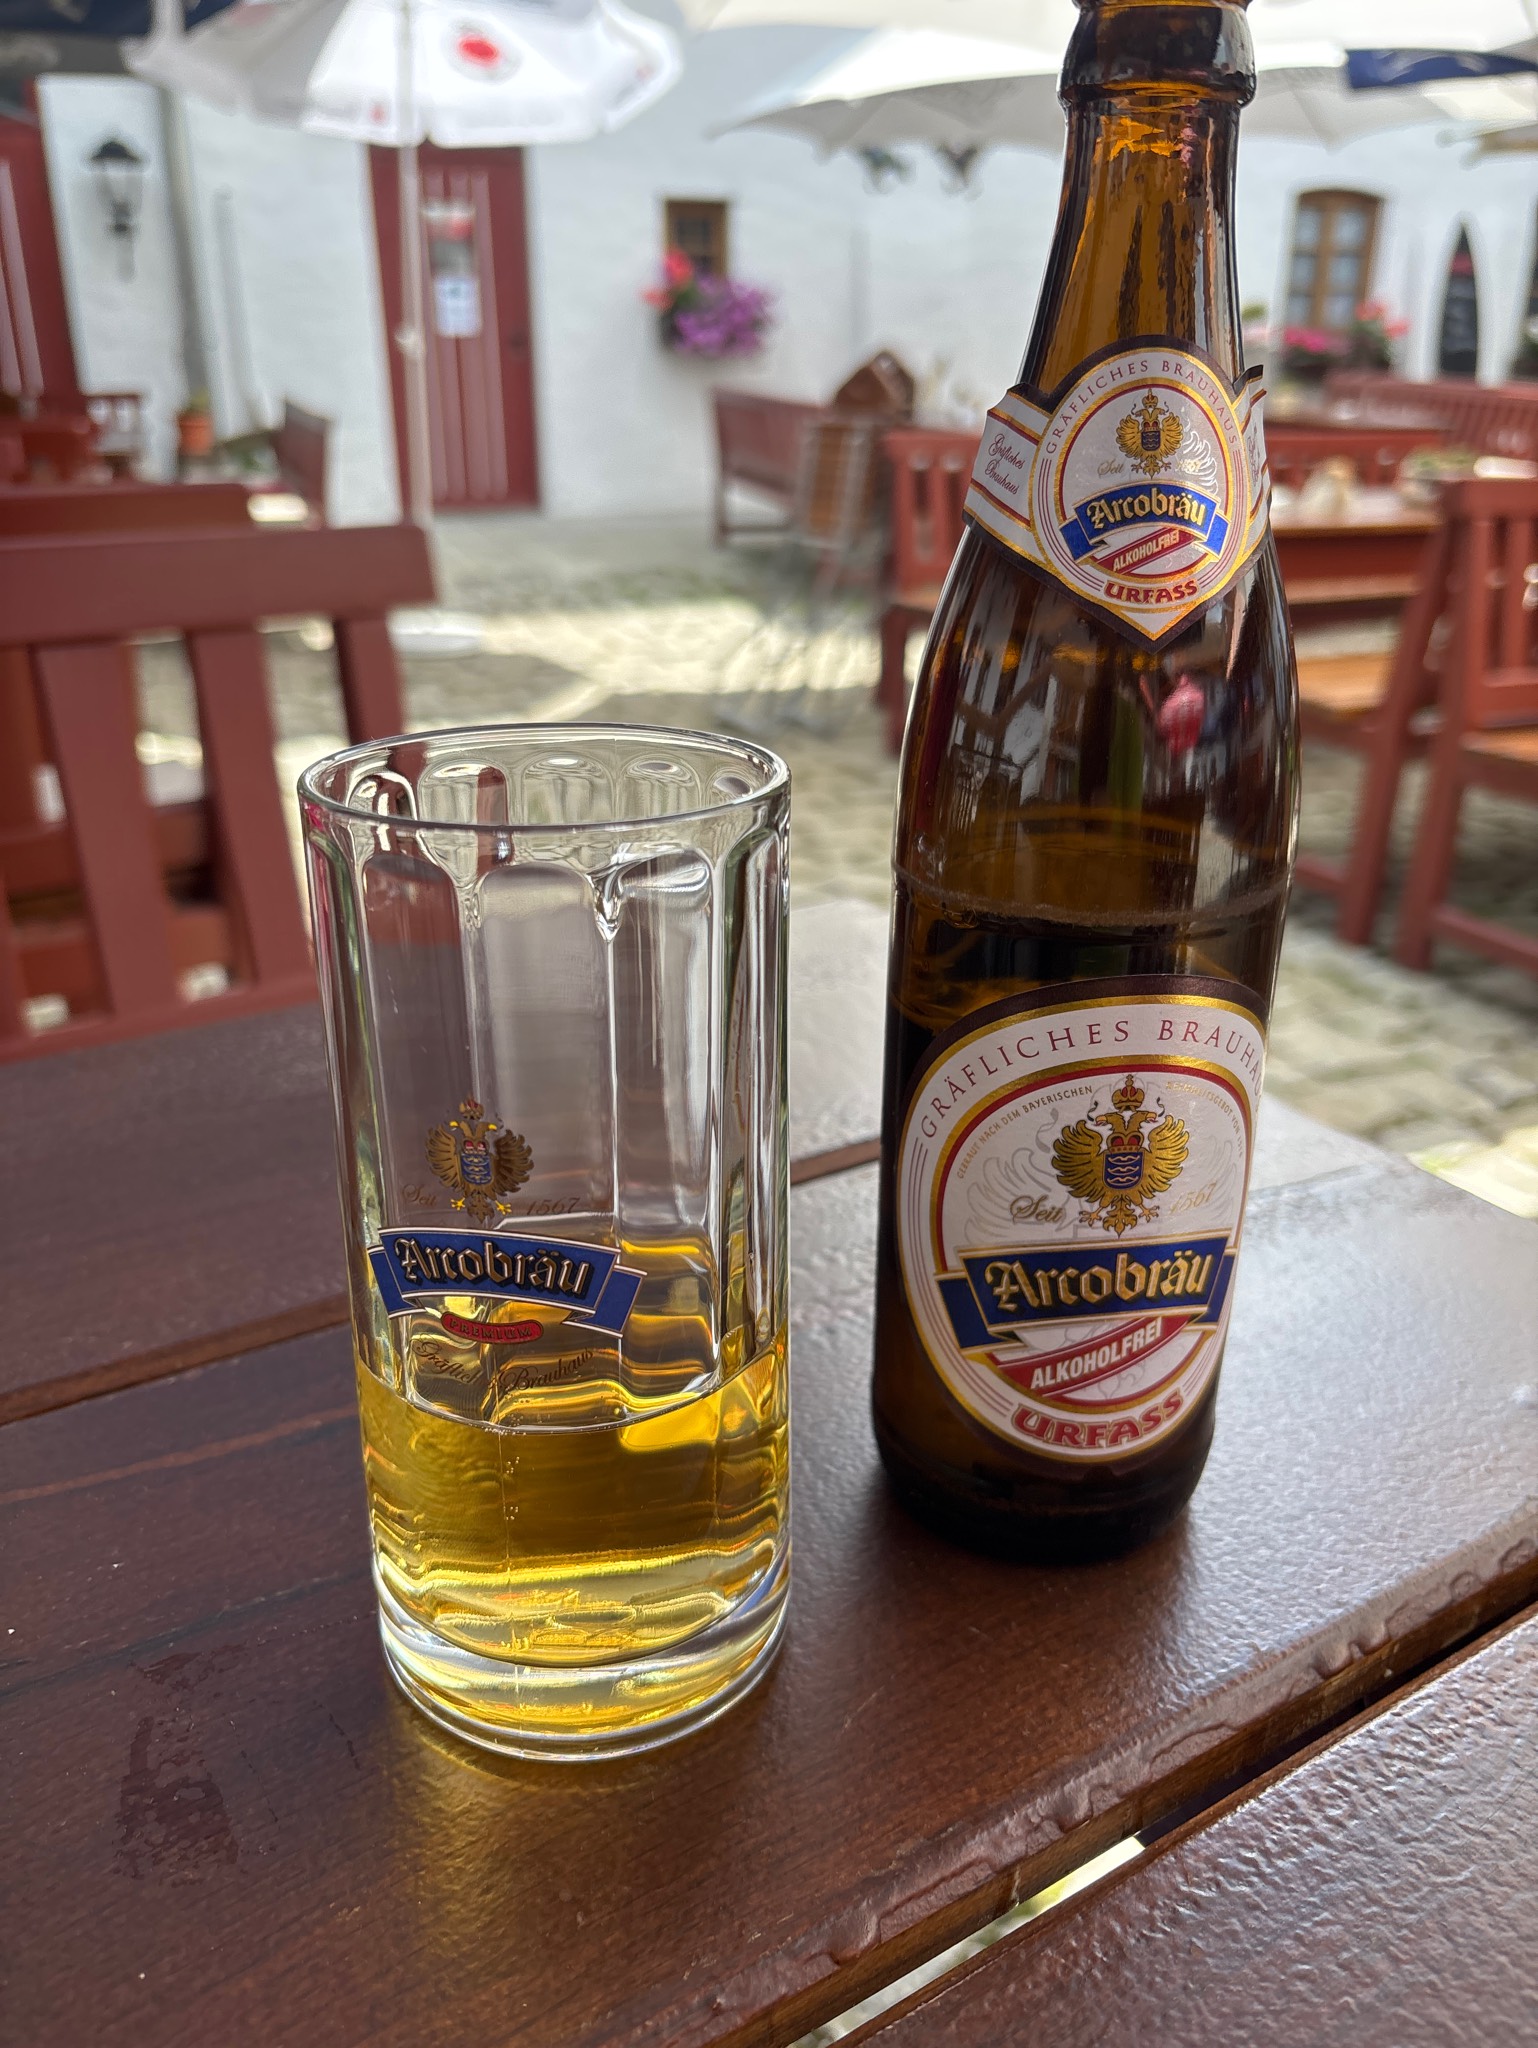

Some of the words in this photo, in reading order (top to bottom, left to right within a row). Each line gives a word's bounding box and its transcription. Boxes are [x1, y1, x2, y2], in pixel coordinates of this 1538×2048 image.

[1047, 360, 1149, 454] GRÄFLICHES
[1162, 360, 1238, 444] BRAUHAUS
[1087, 487, 1206, 529] Arcobräu
[1112, 529, 1180, 571] ALKOHOLFREI
[1104, 579, 1198, 604] URFASS
[921, 1020, 1130, 1139] GRÄFLICHES
[1157, 1019, 1262, 1110] BRAUHAU
[957, 1142, 980, 1179] GEBRAUT
[979, 1121, 1001, 1144] NACH
[1001, 1109, 1021, 1126] DEM
[1022, 1085, 1093, 1114] BAYERISCHEN
[401, 1183, 436, 1207] Seit
[526, 1197, 580, 1216] 1567
[1009, 1194, 1063, 1225] Seit
[1169, 1180, 1218, 1216] 1567
[393, 1237, 591, 1294] Arcobräu
[984, 1250, 1210, 1311] Arcobräu
[449, 1318, 532, 1339] PREMIUM
[1030, 1316, 1164, 1389] ALKOHOLFREI
[497, 1347, 594, 1391] Brauhaus
[1011, 1387, 1185, 1448] URFASS
